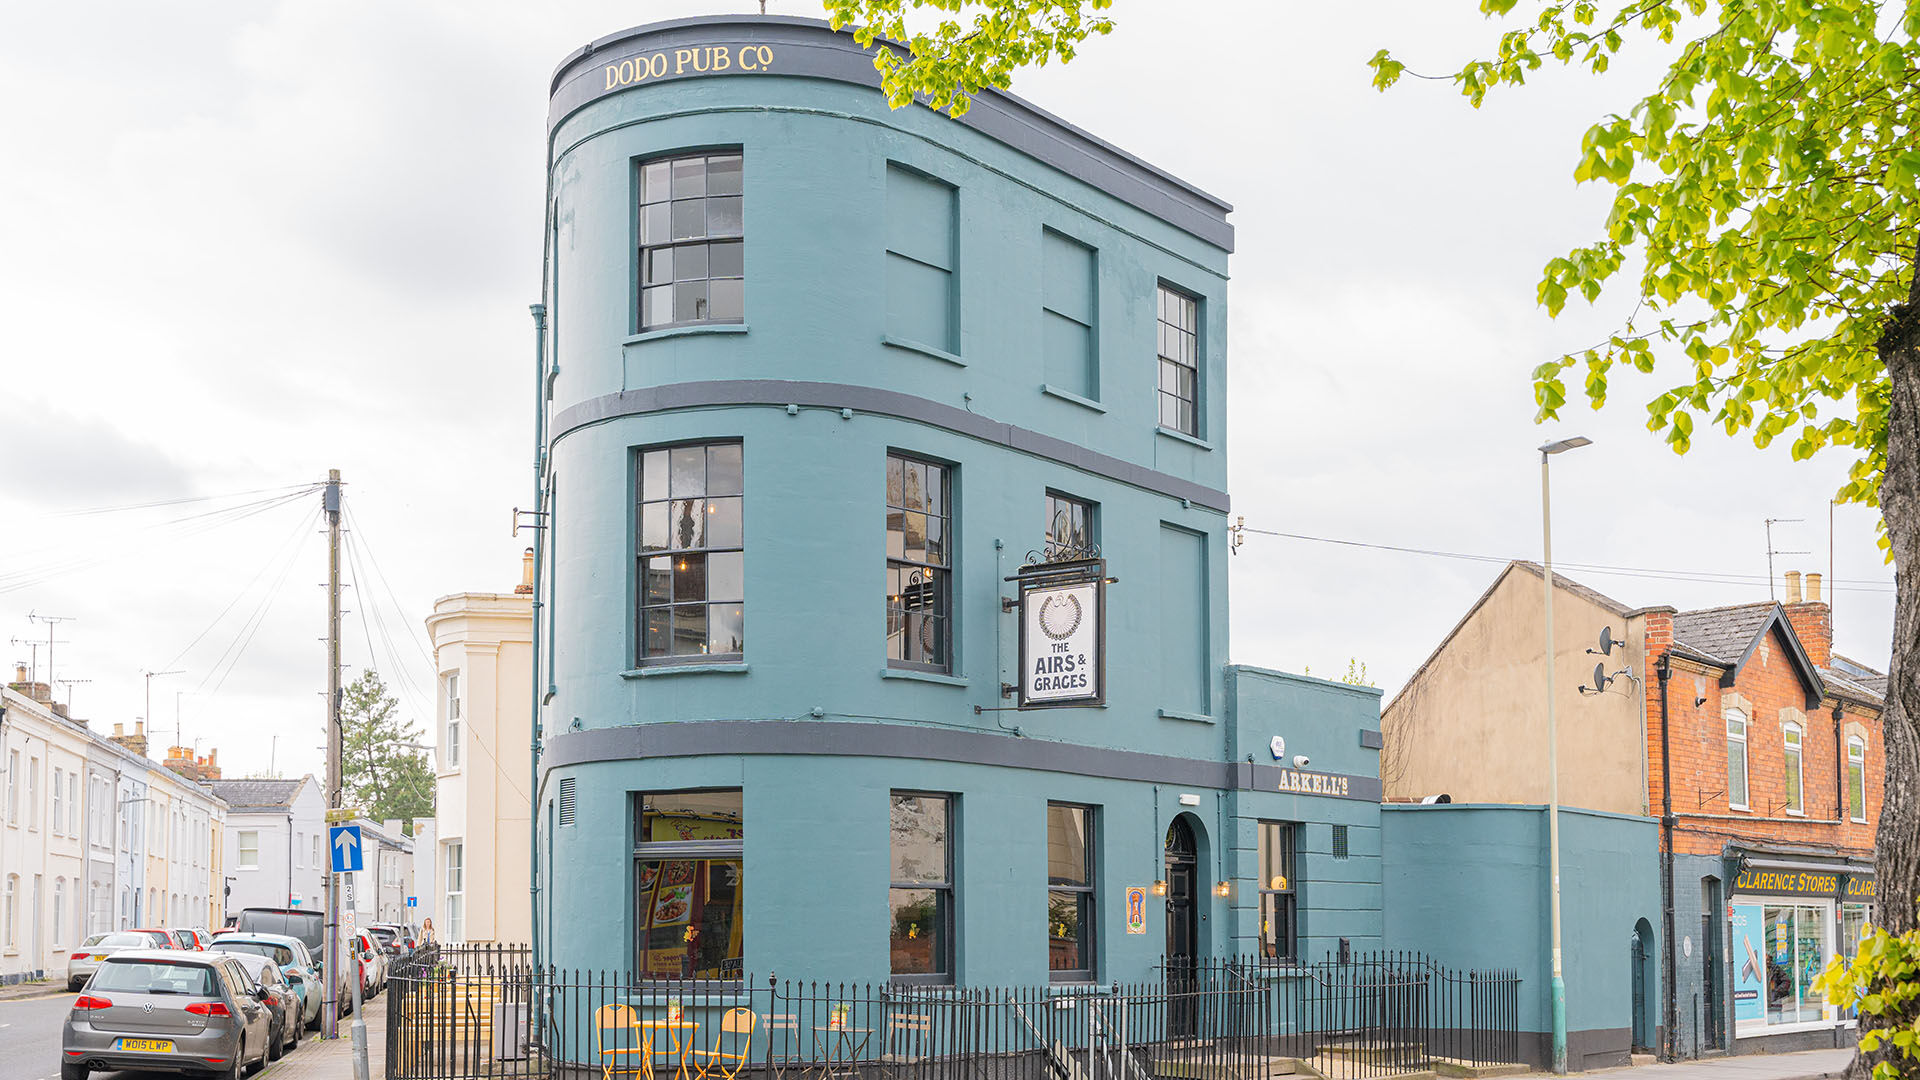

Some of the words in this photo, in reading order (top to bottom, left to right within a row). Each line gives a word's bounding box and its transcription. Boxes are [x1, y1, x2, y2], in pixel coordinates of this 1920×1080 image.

[605, 53, 668, 90] DODO
[675, 46, 731, 75] PUB
[1051, 642, 1070, 653] THE
[1035, 654, 1076, 675] AIRS
[1078, 654, 1087, 665] &
[1034, 673, 1088, 692] GRACES
[1737, 870, 1797, 891] CLARENCE
[1797, 872, 1837, 892] STORES
[149, 1041, 168, 1051] LWP
